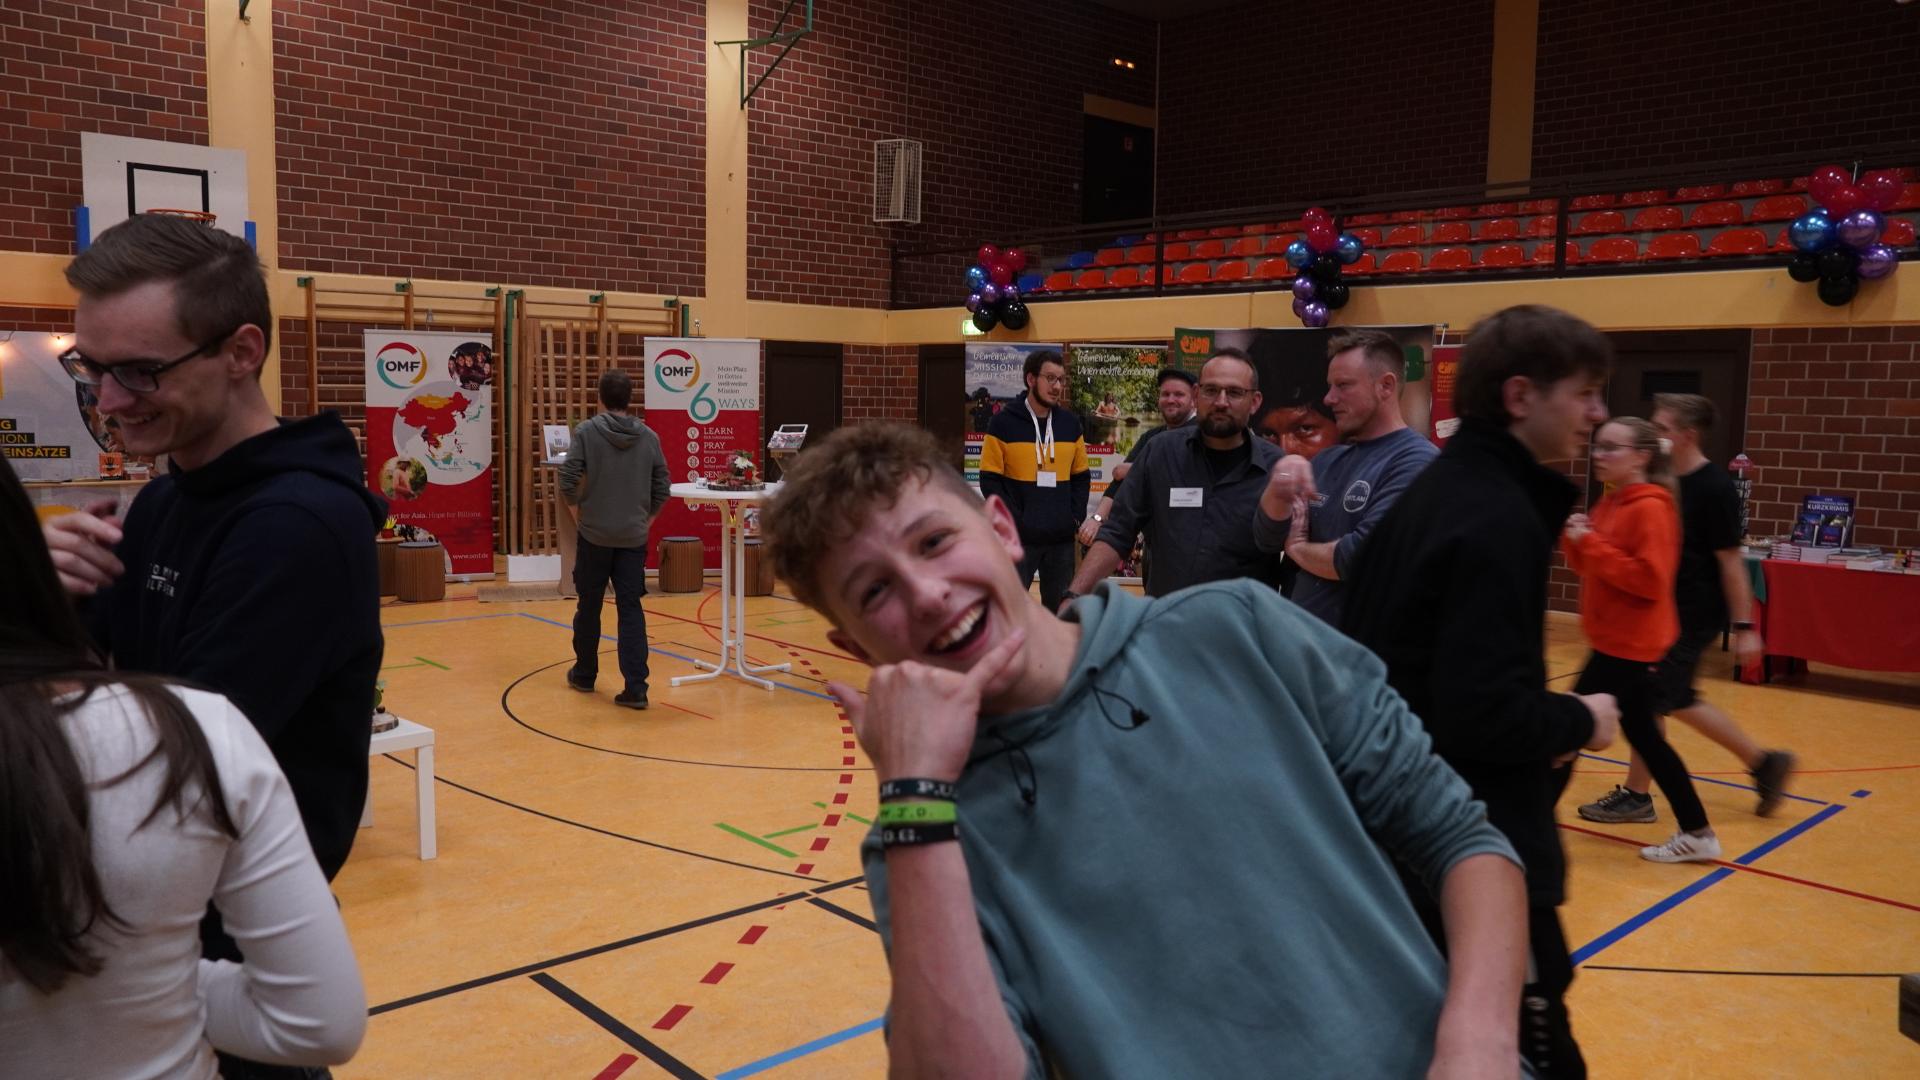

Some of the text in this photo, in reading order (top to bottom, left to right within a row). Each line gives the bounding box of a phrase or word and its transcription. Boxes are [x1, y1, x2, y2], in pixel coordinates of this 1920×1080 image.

[385, 361, 420, 372] OMF
[662, 366, 694, 376] OMF
[974, 363, 1014, 371] MISSION
[690, 383, 717, 420] 6
[718, 399, 756, 409] WAYS
[704, 427, 733, 435] LEARN
[704, 456, 717, 464] GO
[1807, 503, 1849, 512] KURZKRIMIS
